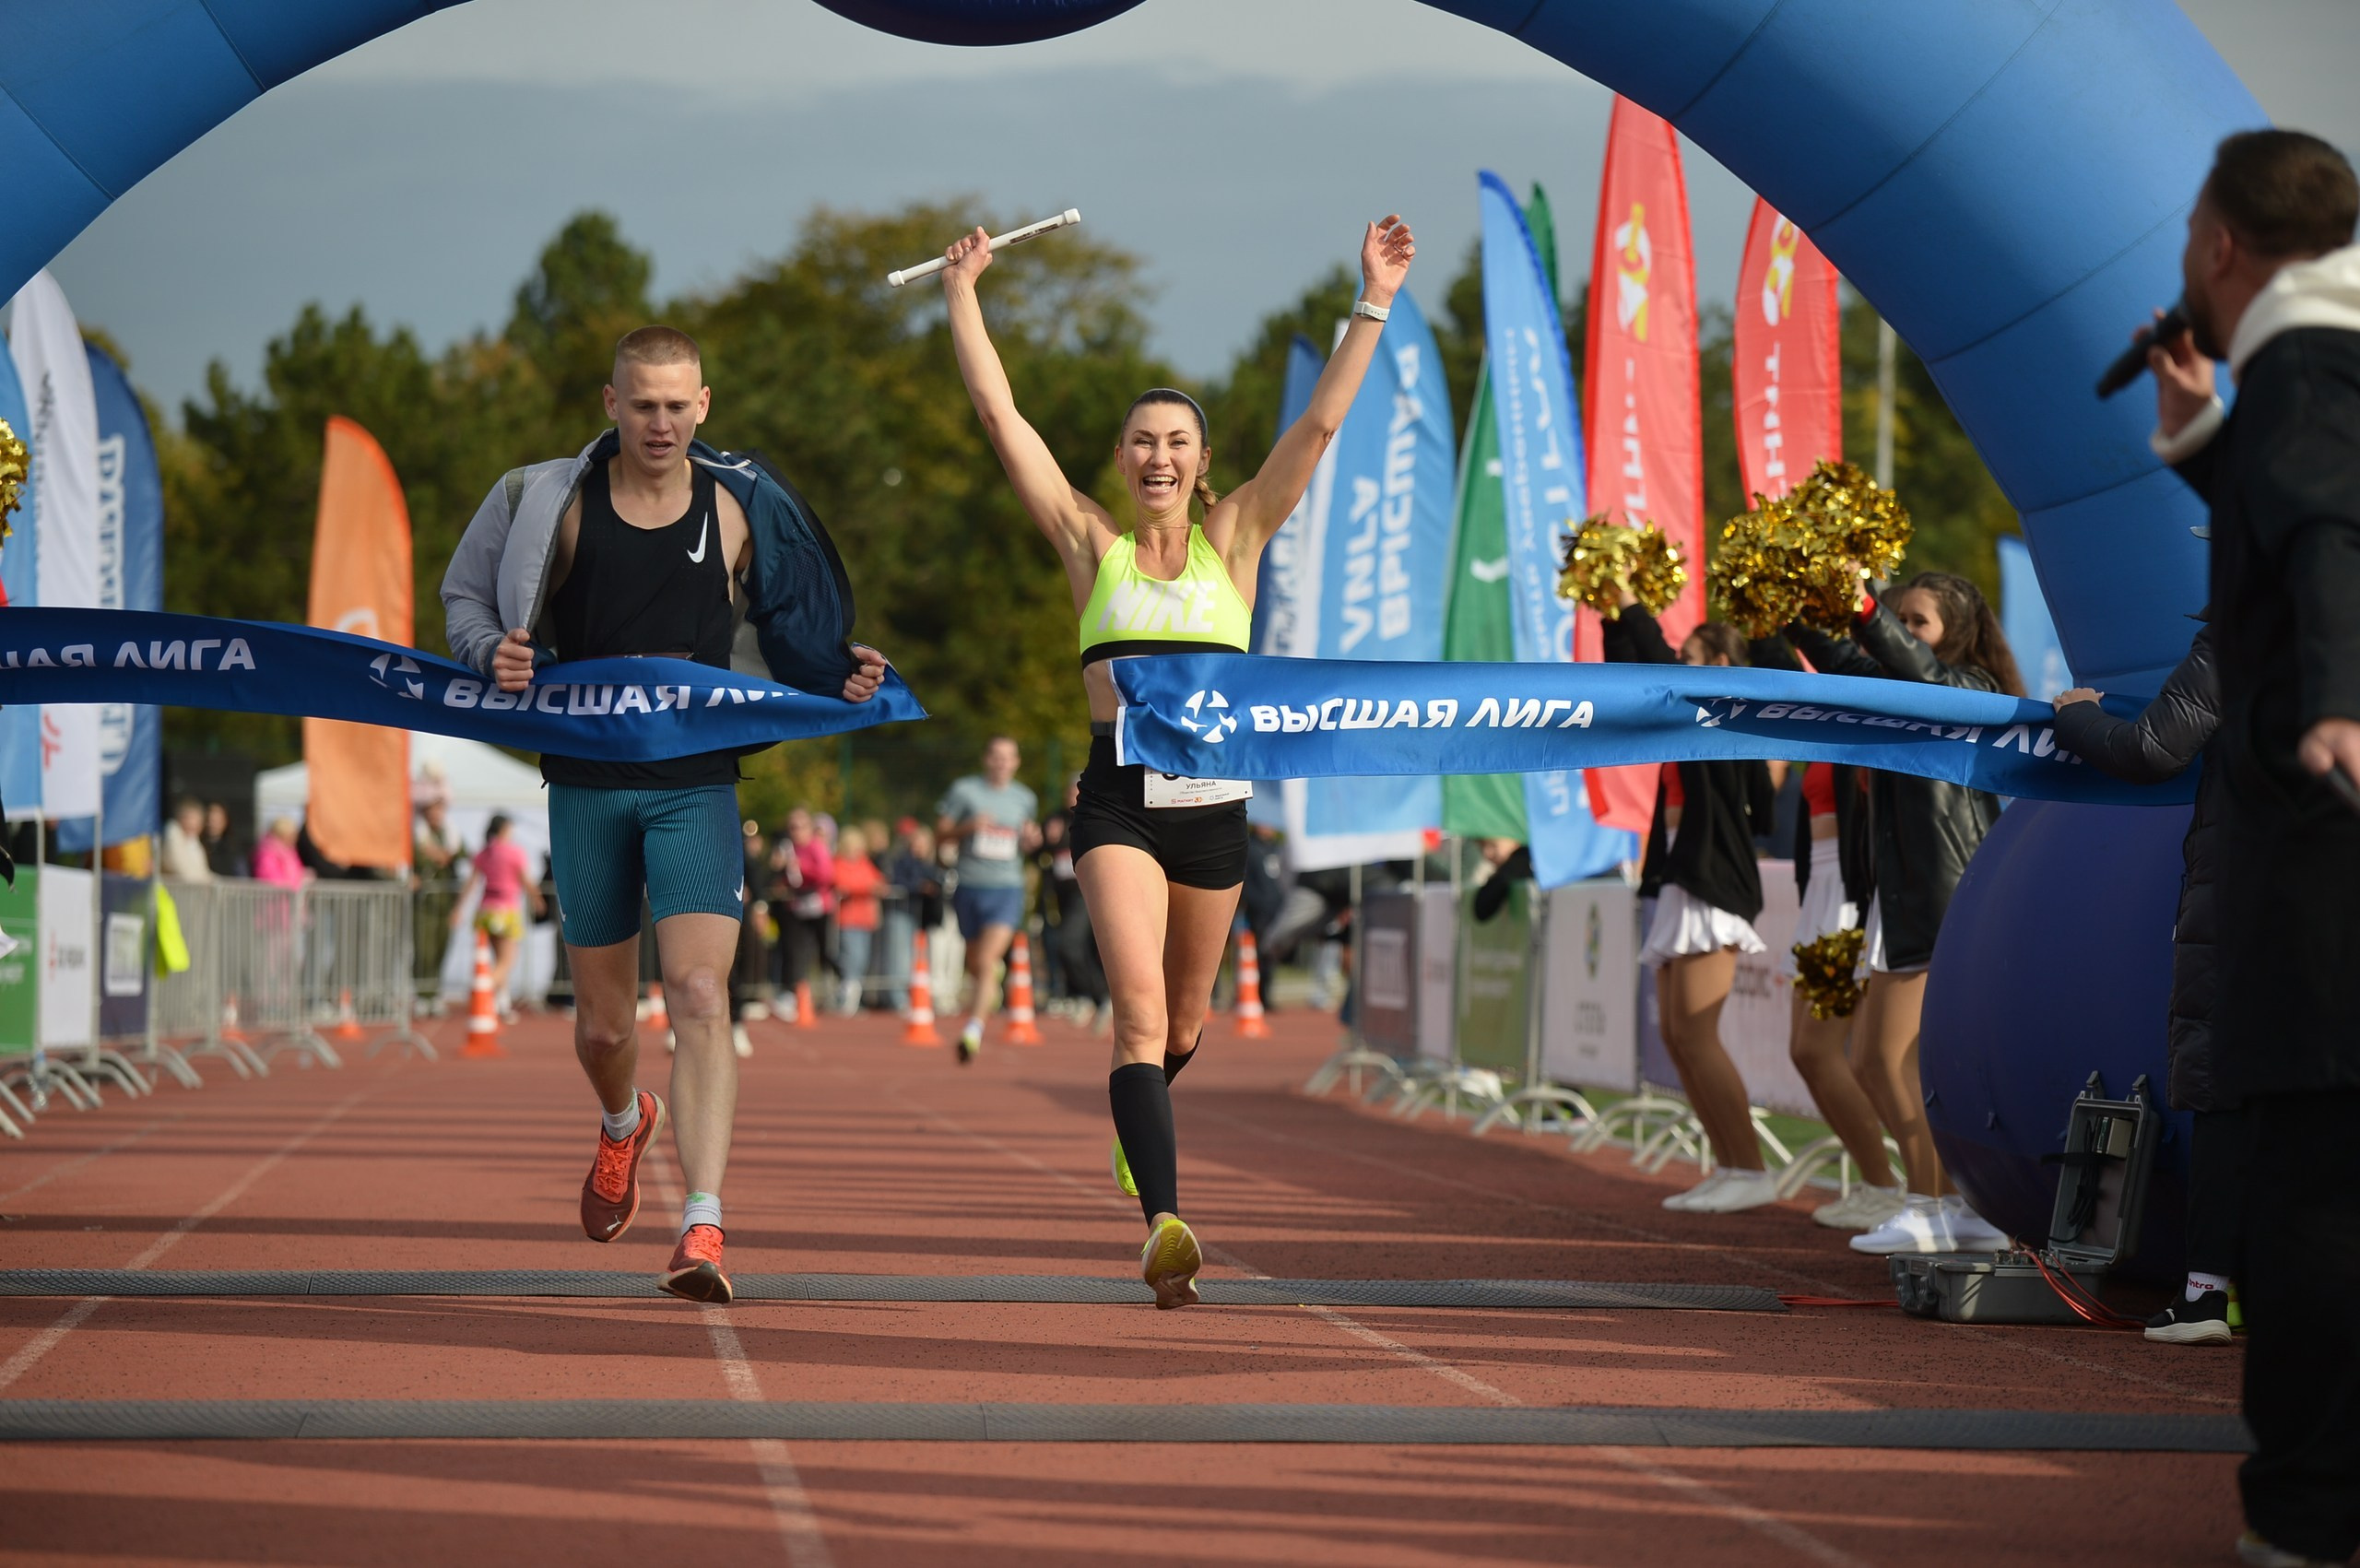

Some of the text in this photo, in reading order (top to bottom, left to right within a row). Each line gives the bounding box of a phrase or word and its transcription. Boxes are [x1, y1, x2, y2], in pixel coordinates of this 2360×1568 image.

[1096, 580, 1219, 633] NIKE
[113, 638, 256, 670] ЛИГА
[443, 678, 691, 715] ВЫСШАЯ
[1250, 698, 1594, 733] ВЫСШАЯ ЛИГА
[1186, 781, 1217, 790] УЛЬЯНА
